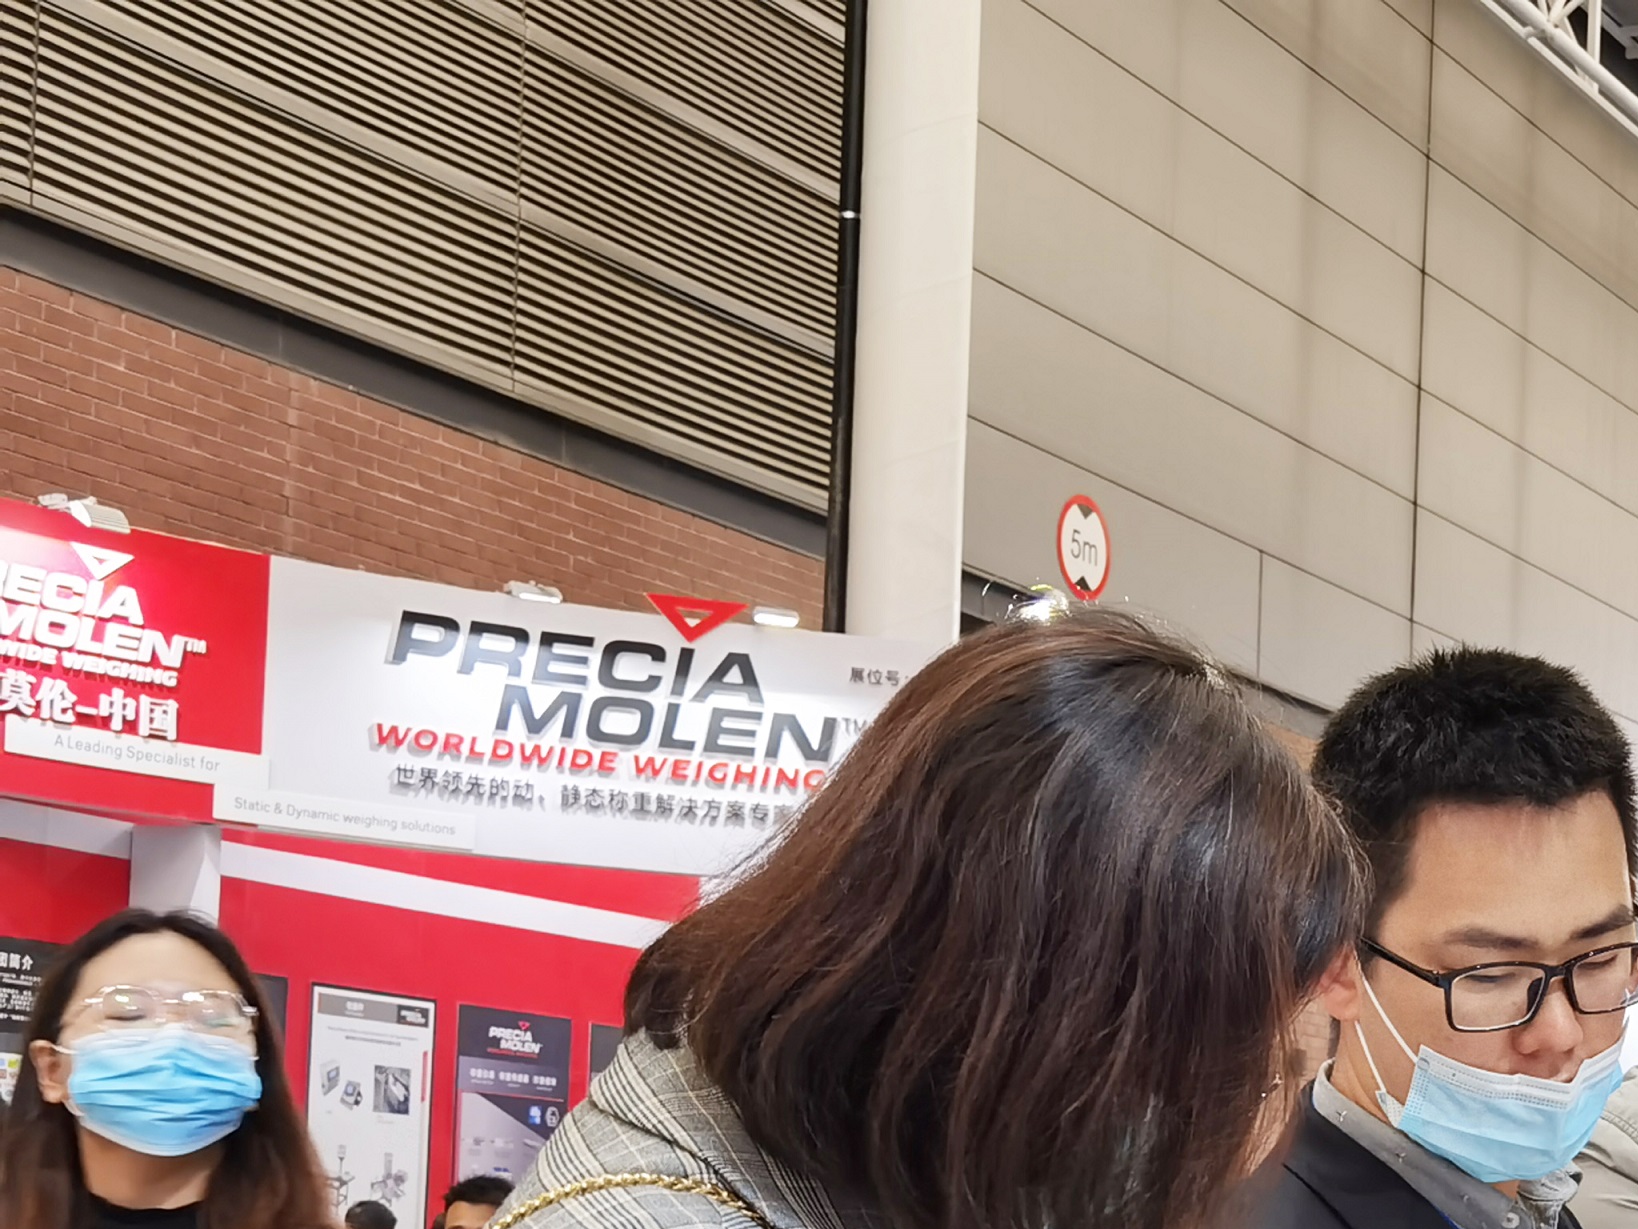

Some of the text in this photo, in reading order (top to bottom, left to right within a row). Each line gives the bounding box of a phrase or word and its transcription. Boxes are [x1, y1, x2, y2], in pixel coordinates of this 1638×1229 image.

[1070, 529, 1098, 567] 5m
[0, 560, 144, 626] ECIA
[61, 651, 178, 688] WEIGHING
[391, 609, 764, 703] PRECIA
[54, 734, 220, 773] A Leading Specialist for
[376, 723, 828, 792] WORLDWIDE WEIGHING
[234, 796, 456, 836] Static & Dynamic weighing solutions
[488, 1026, 533, 1042] PRECIA
